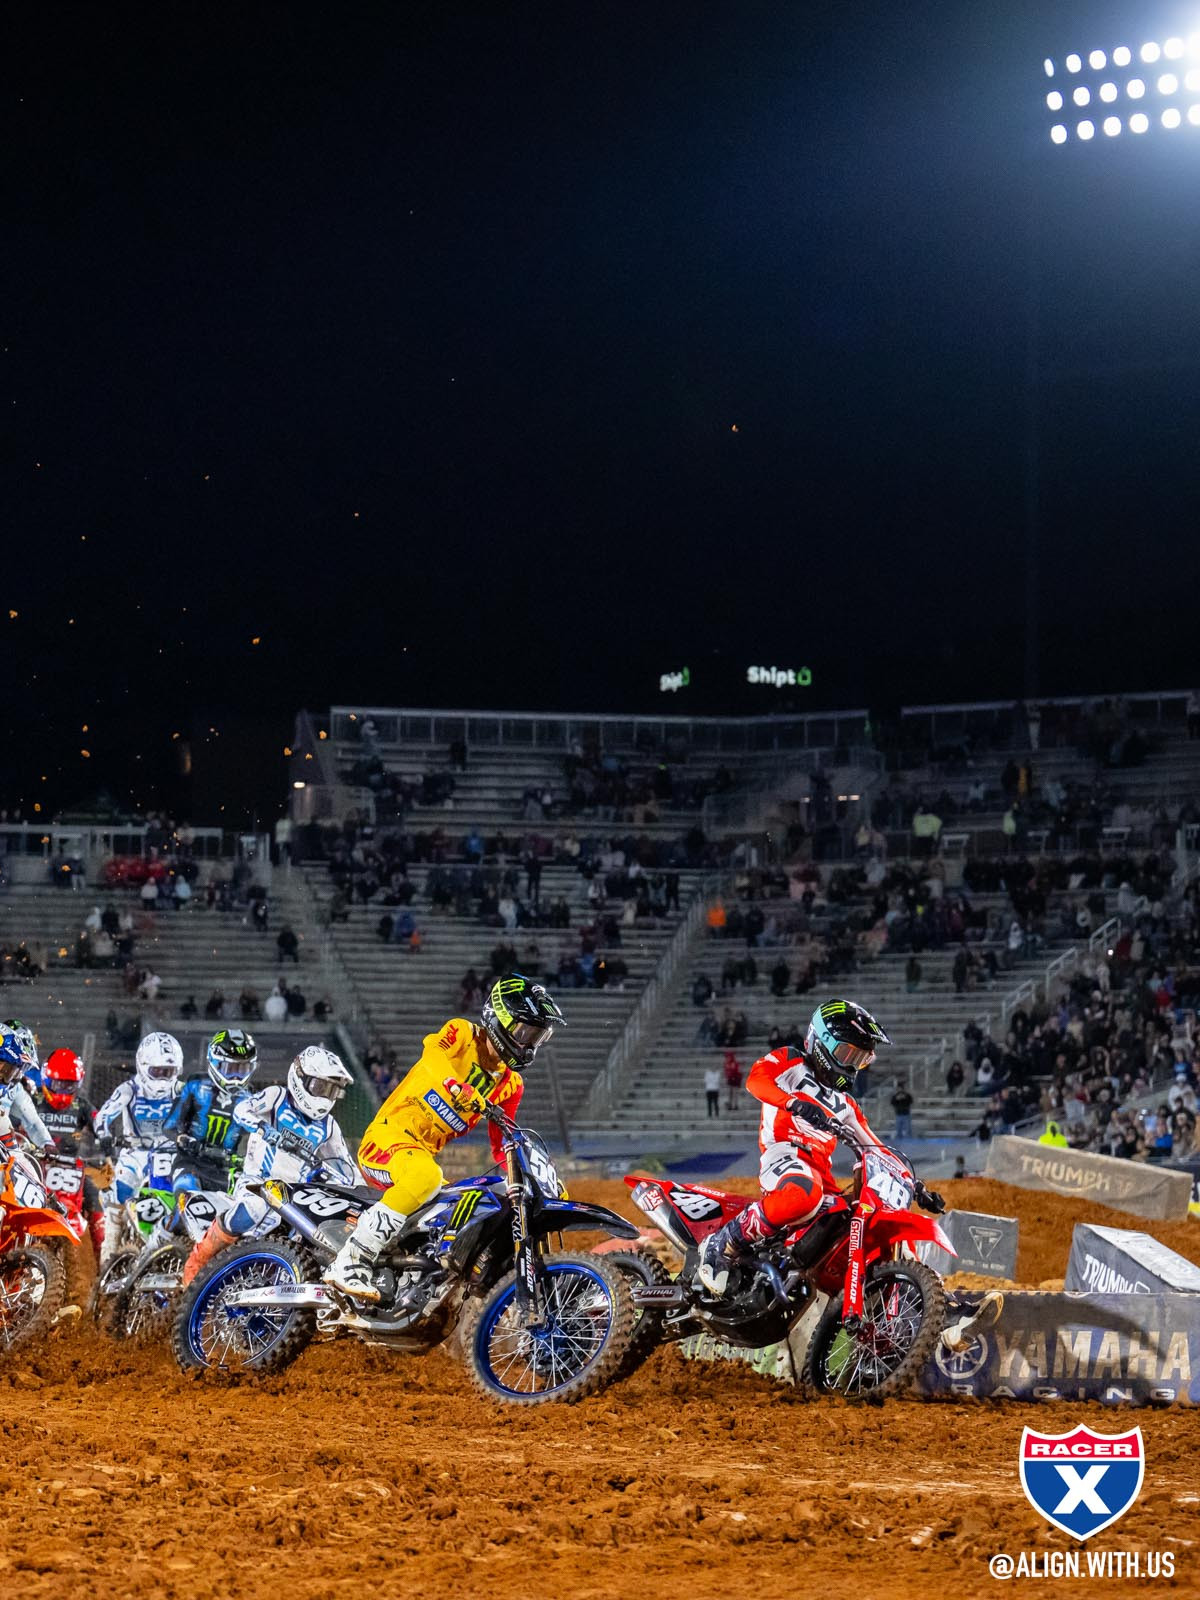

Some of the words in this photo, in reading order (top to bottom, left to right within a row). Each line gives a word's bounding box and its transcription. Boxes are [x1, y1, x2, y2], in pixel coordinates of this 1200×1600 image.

[747, 666, 796, 688] Shipt
[436, 1102, 468, 1133] YAMAHA
[13, 1171, 46, 1209] 16
[45, 1167, 83, 1194] 65
[530, 1148, 559, 1199] 59
[1019, 1154, 1111, 1193] TRIUMPH
[292, 1187, 350, 1217] 59
[669, 1191, 721, 1221] 48
[692, 1185, 726, 1199] HONDA
[867, 1172, 912, 1211] 48
[525, 1246, 534, 1293] DUNLOP
[850, 1262, 860, 1305] DUNLOP
[1081, 1253, 1134, 1294] TRIUMPH
[280, 1286, 307, 1294] YAMALUBE
[996, 1330, 1192, 1381] YAMAHA
[950, 1383, 1176, 1401] RACING
